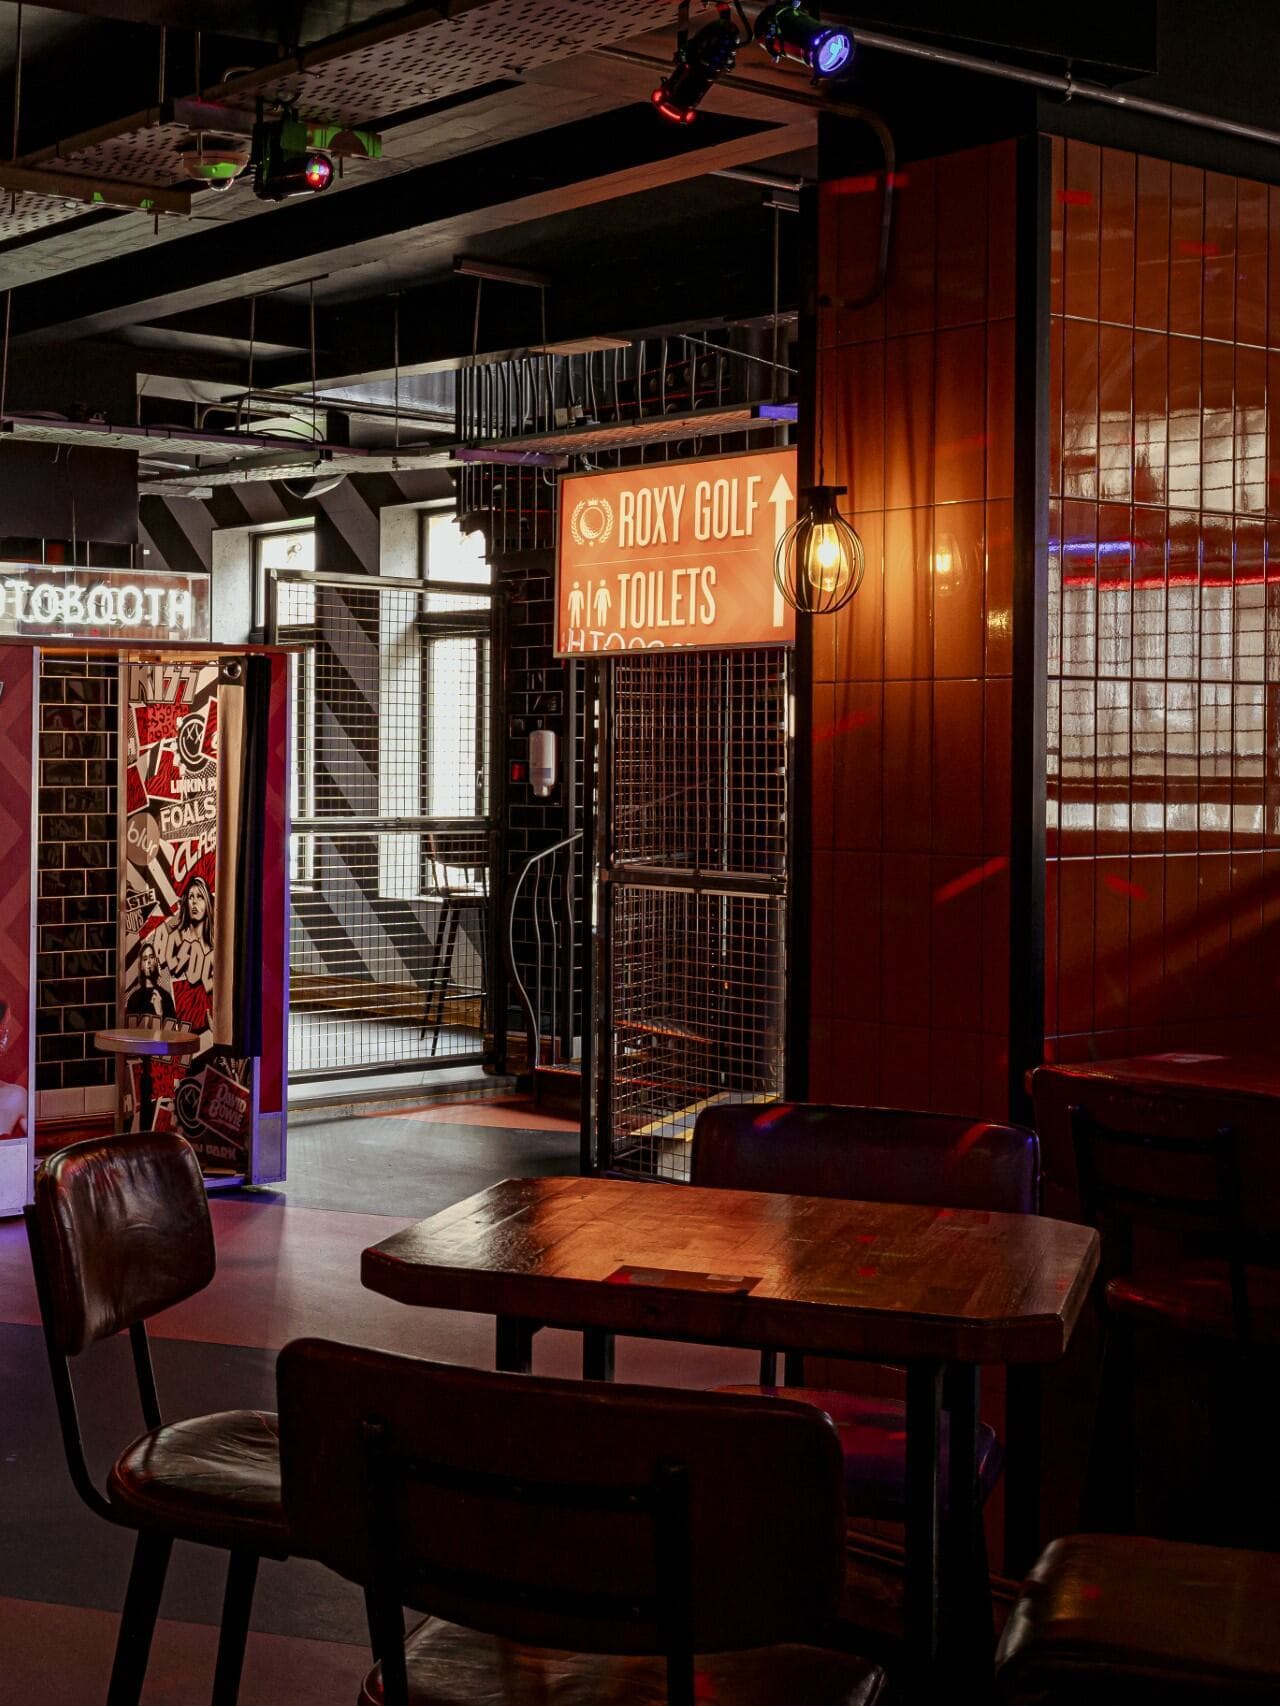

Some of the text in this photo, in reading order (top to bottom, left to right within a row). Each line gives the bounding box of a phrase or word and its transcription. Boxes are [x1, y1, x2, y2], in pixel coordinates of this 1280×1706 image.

[618, 476, 762, 547] ROXY GOLF
[617, 565, 717, 629] TOILETS
[128, 663, 198, 704] KISS
[160, 797, 217, 832] FOALS
[127, 820, 158, 857] blur
[208, 1099, 244, 1128] BOWIE
[216, 1083, 247, 1114] DAVID
